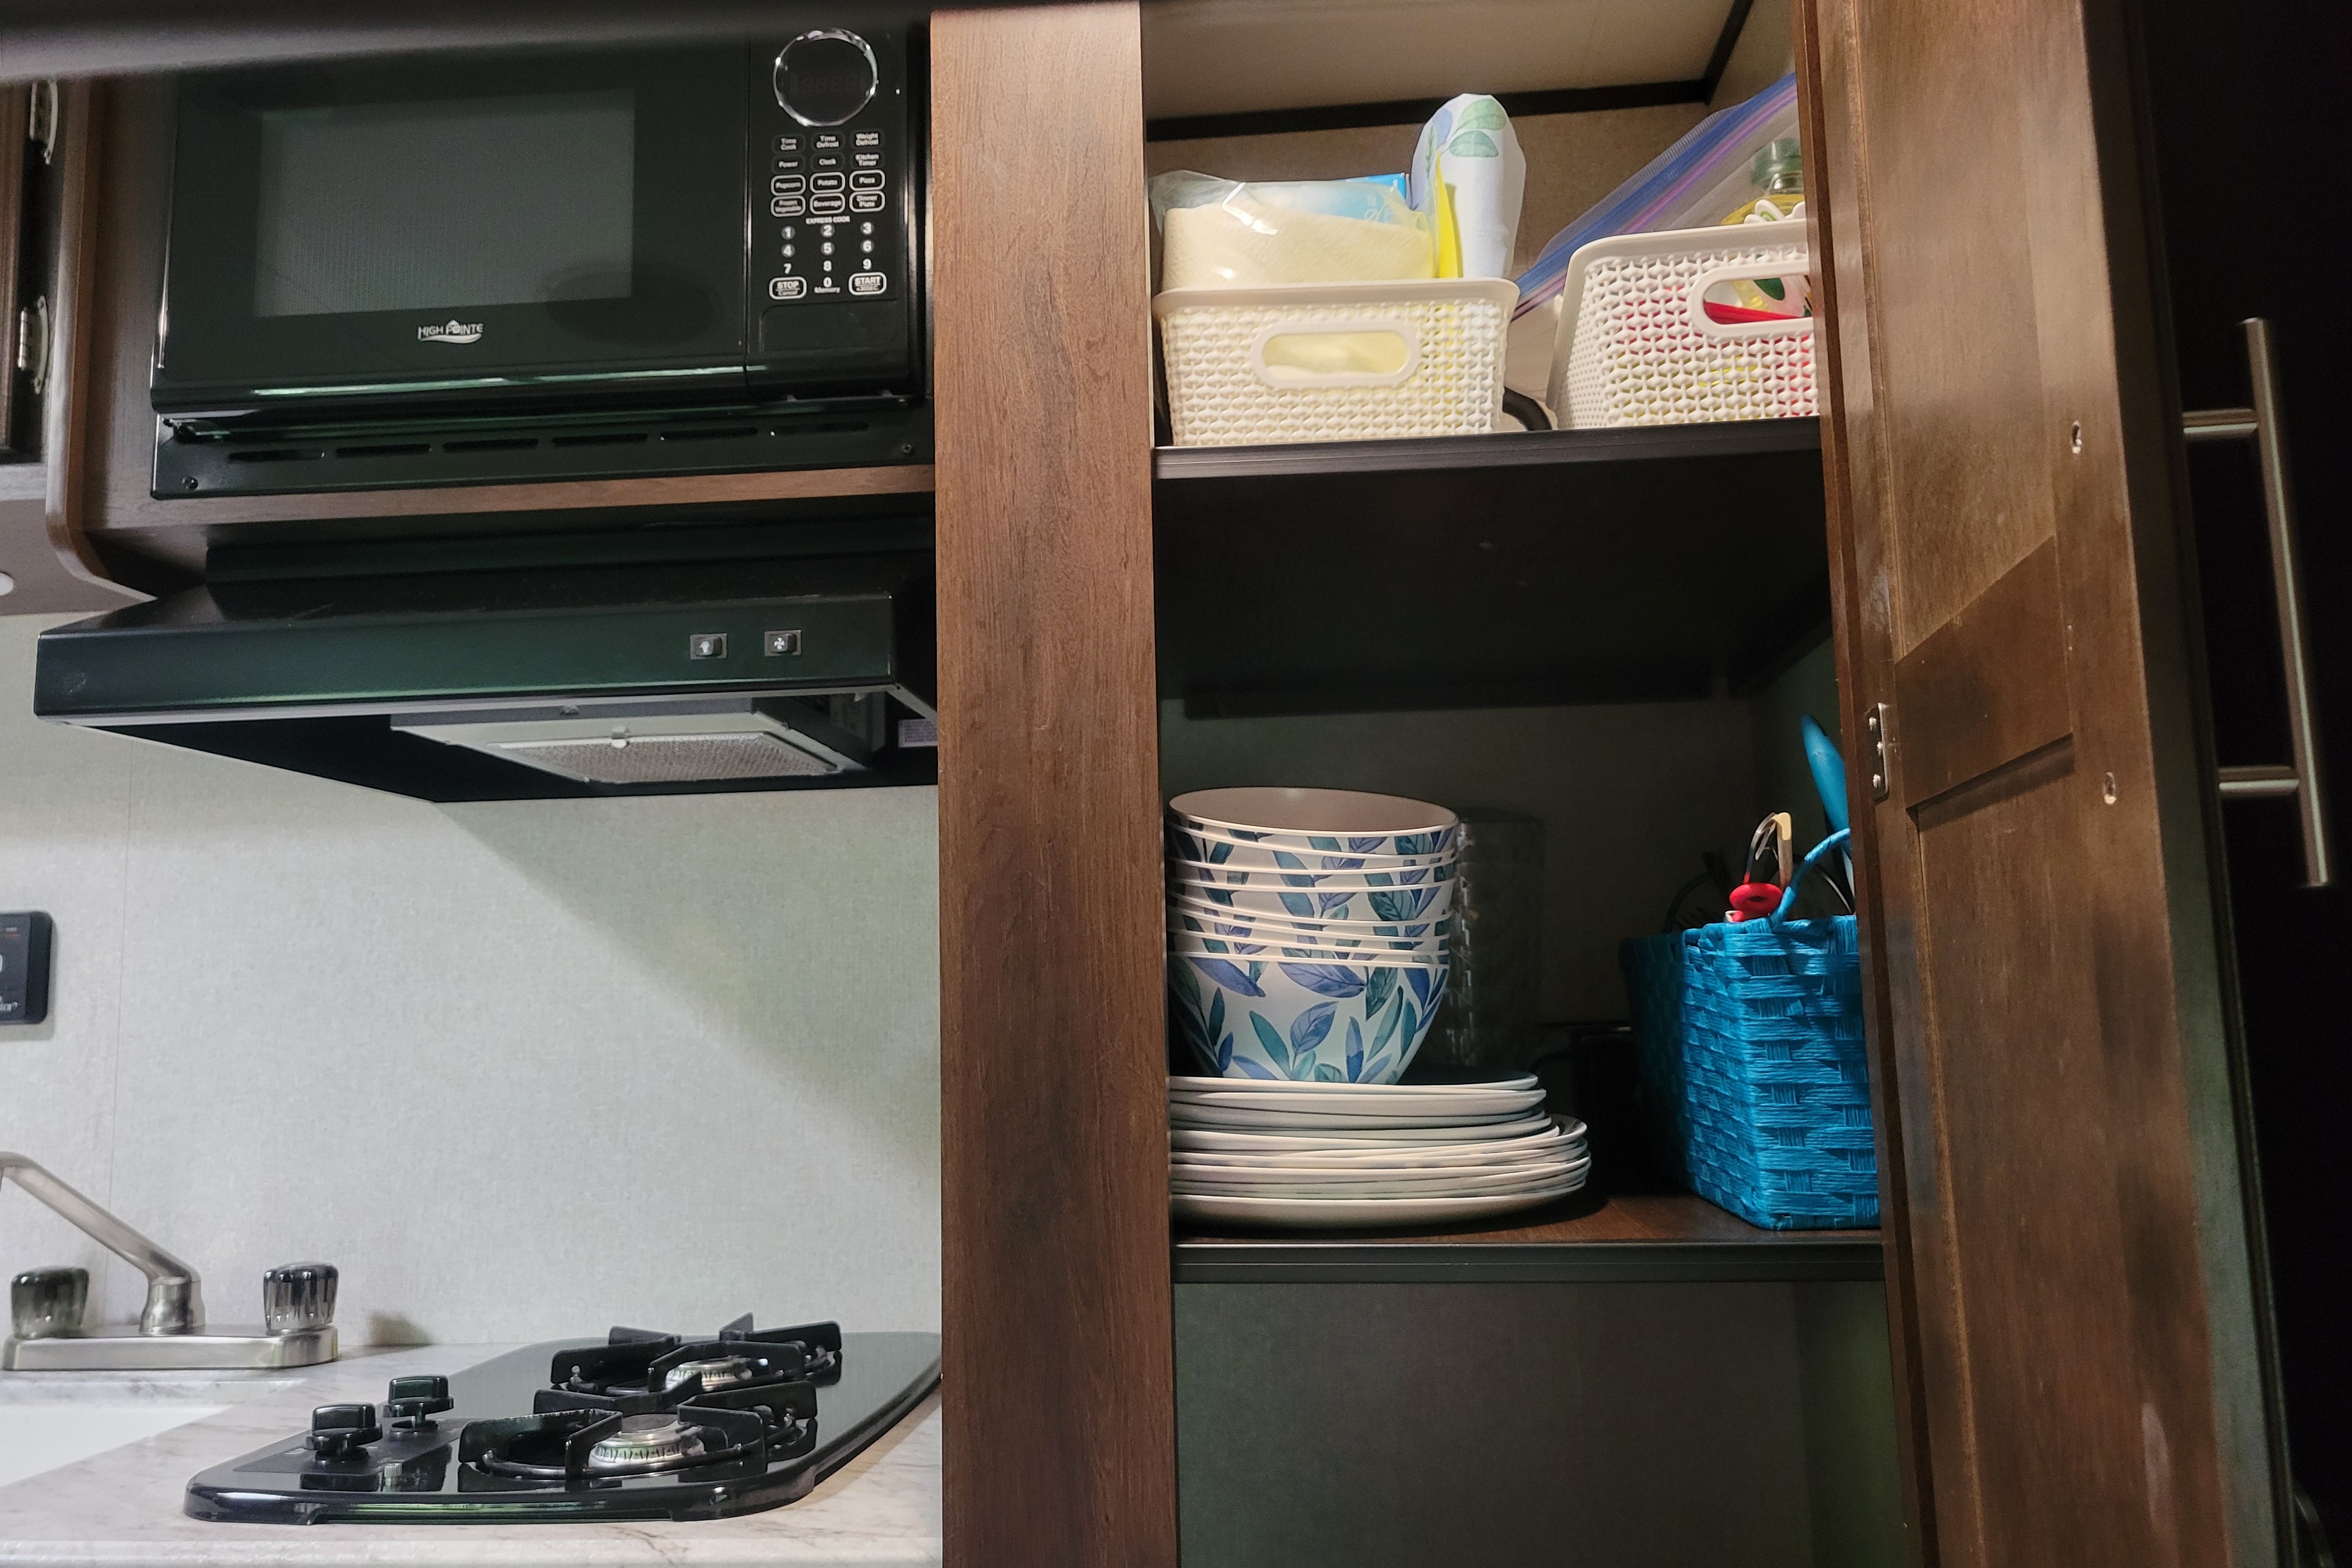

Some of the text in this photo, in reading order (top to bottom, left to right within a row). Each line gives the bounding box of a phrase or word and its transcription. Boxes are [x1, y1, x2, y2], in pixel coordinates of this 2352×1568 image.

[785, 228, 791, 238] 1
[823, 225, 832, 236] 2
[863, 223, 872, 234] 3
[783, 245, 792, 256] 4
[823, 242, 832, 254] 5
[863, 240, 872, 251] 6
[783, 263, 792, 274] 7
[823, 261, 832, 272] 8
[863, 258, 872, 270] 9
[777, 281, 799, 289] STOP
[823, 276, 832, 287] 0
[855, 276, 881, 285] START
[417, 323, 484, 340] HIGH POINTE
